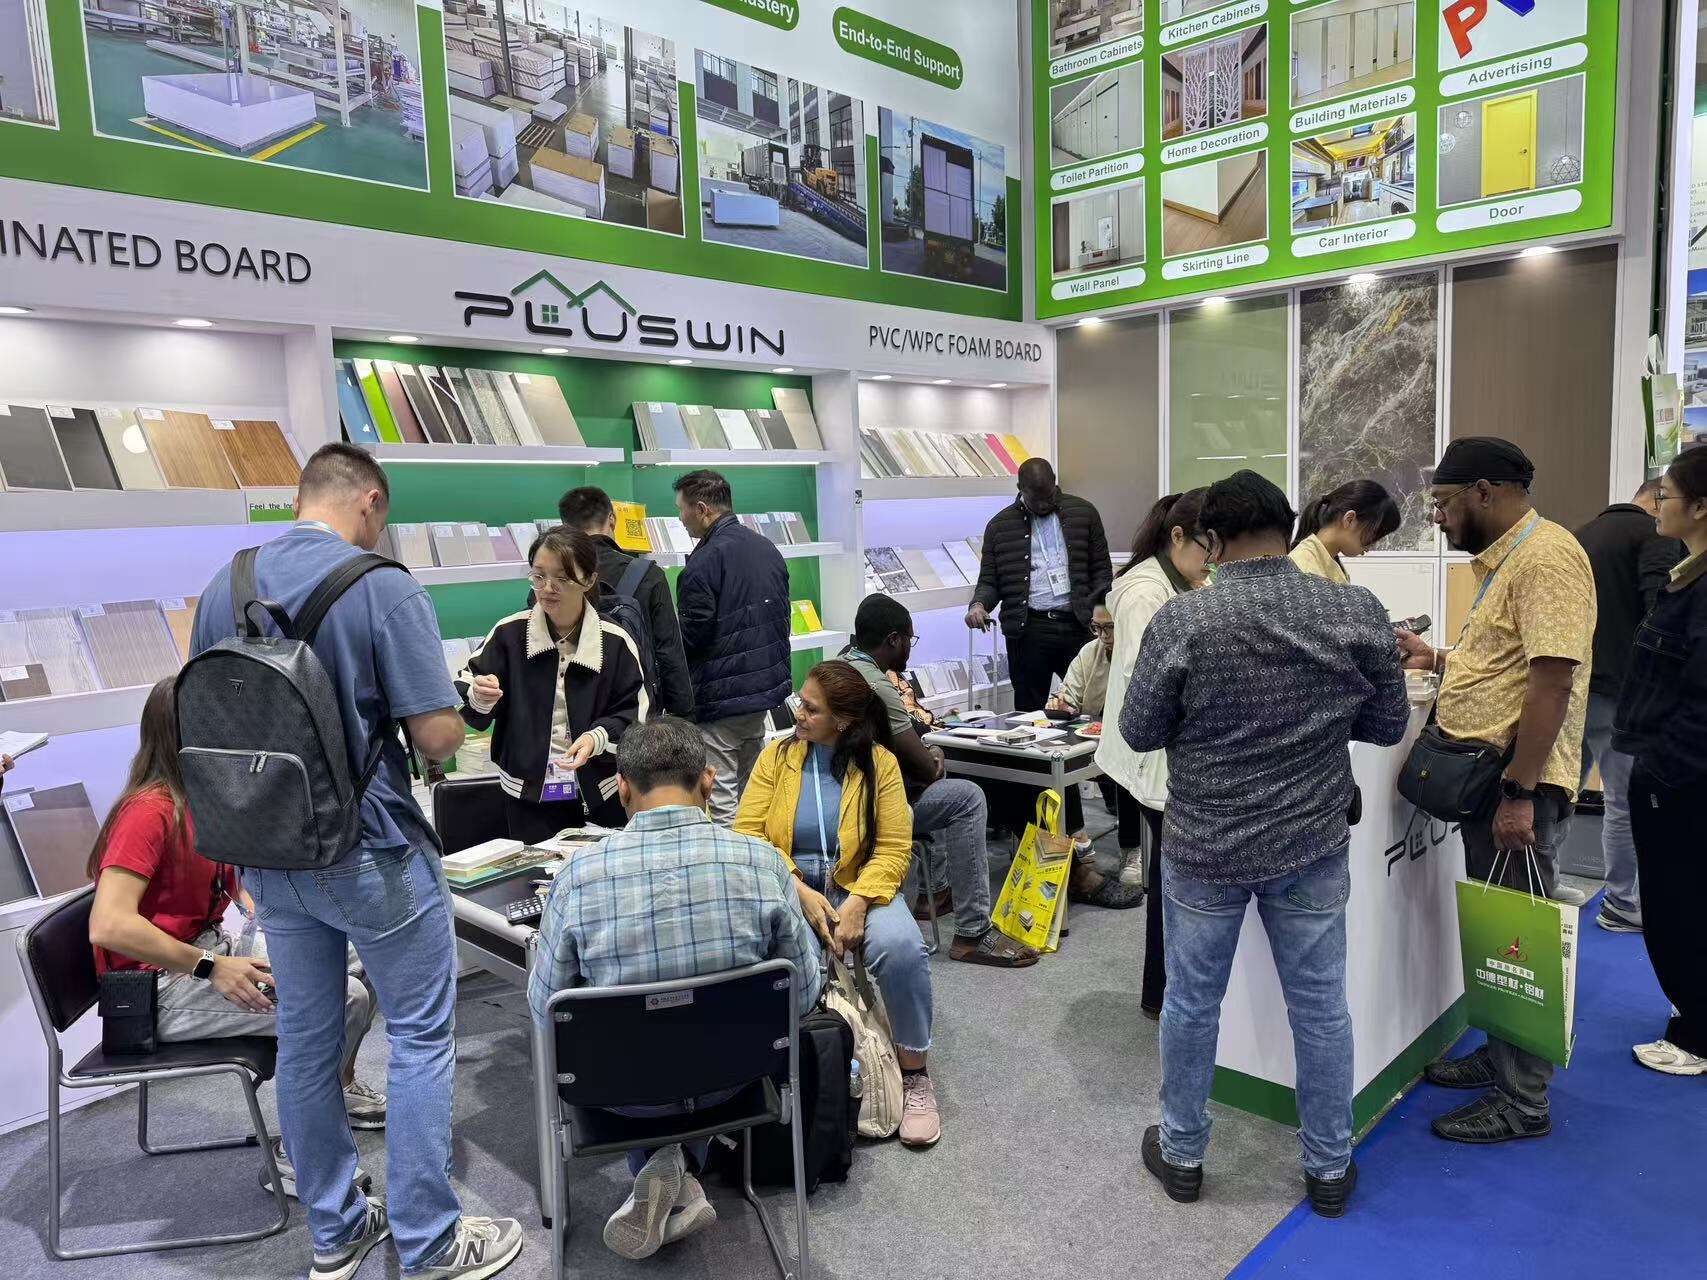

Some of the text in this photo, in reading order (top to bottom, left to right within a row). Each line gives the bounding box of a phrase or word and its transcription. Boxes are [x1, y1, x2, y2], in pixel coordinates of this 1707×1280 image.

[1168, 4, 1260, 40] Kitchen Cabinets
[839, 19, 961, 80] End-to-End Support
[1052, 40, 1143, 76] Bathroom Cabinets
[1468, 55, 1552, 87] Advertising
[1295, 92, 1408, 129] Building Materials
[1167, 128, 1260, 159] Home Decoration
[1060, 161, 1129, 184] Toilet Partition
[1488, 203, 1525, 220] Door
[1319, 227, 1389, 249] Car Interior
[175, 239, 312, 284] BOARD
[1181, 251, 1250, 272] Skirting Line
[1069, 277, 1120, 294] Wall Panel
[455, 284, 785, 356] PLUSWIN
[869, 325, 1042, 363] PVC/WPC FOAM BOARD
[462, 1239, 486, 1267] N
